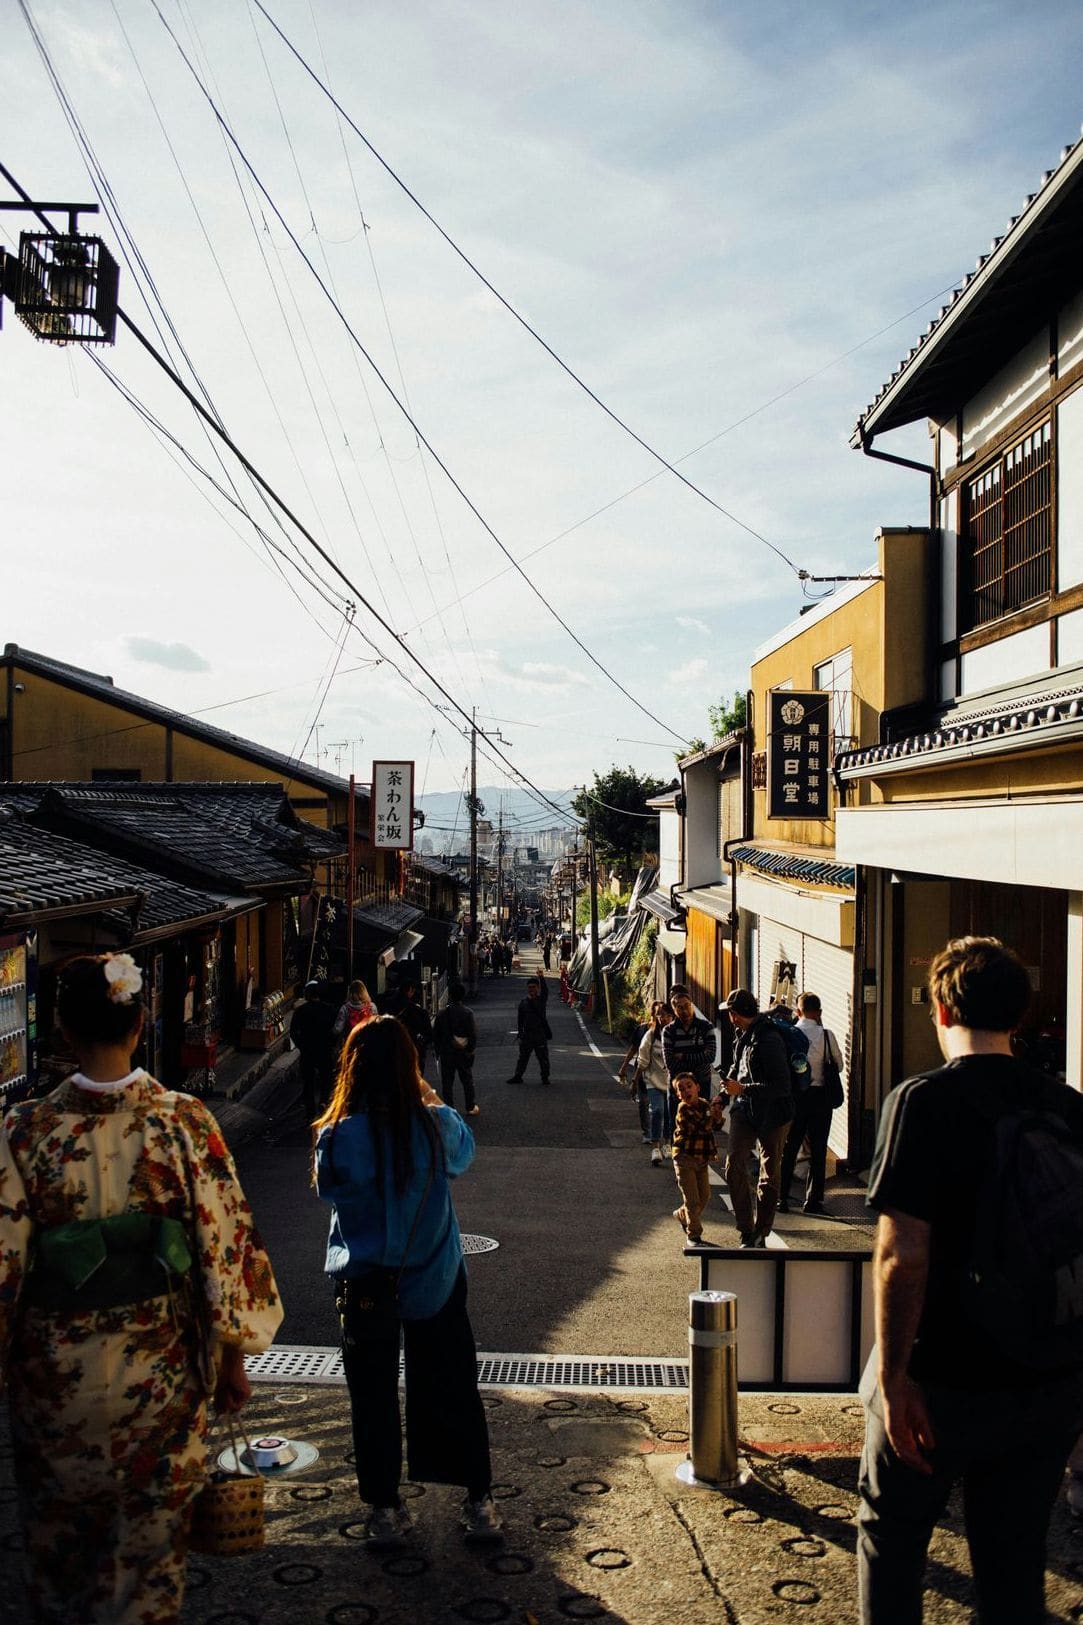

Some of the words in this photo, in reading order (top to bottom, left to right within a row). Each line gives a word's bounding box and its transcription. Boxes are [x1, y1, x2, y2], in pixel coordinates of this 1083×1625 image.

[783, 734, 802, 803] 朝日堂
[808, 723, 820, 805] 専用駐車場
[386, 770, 402, 840] 茶わん坂
